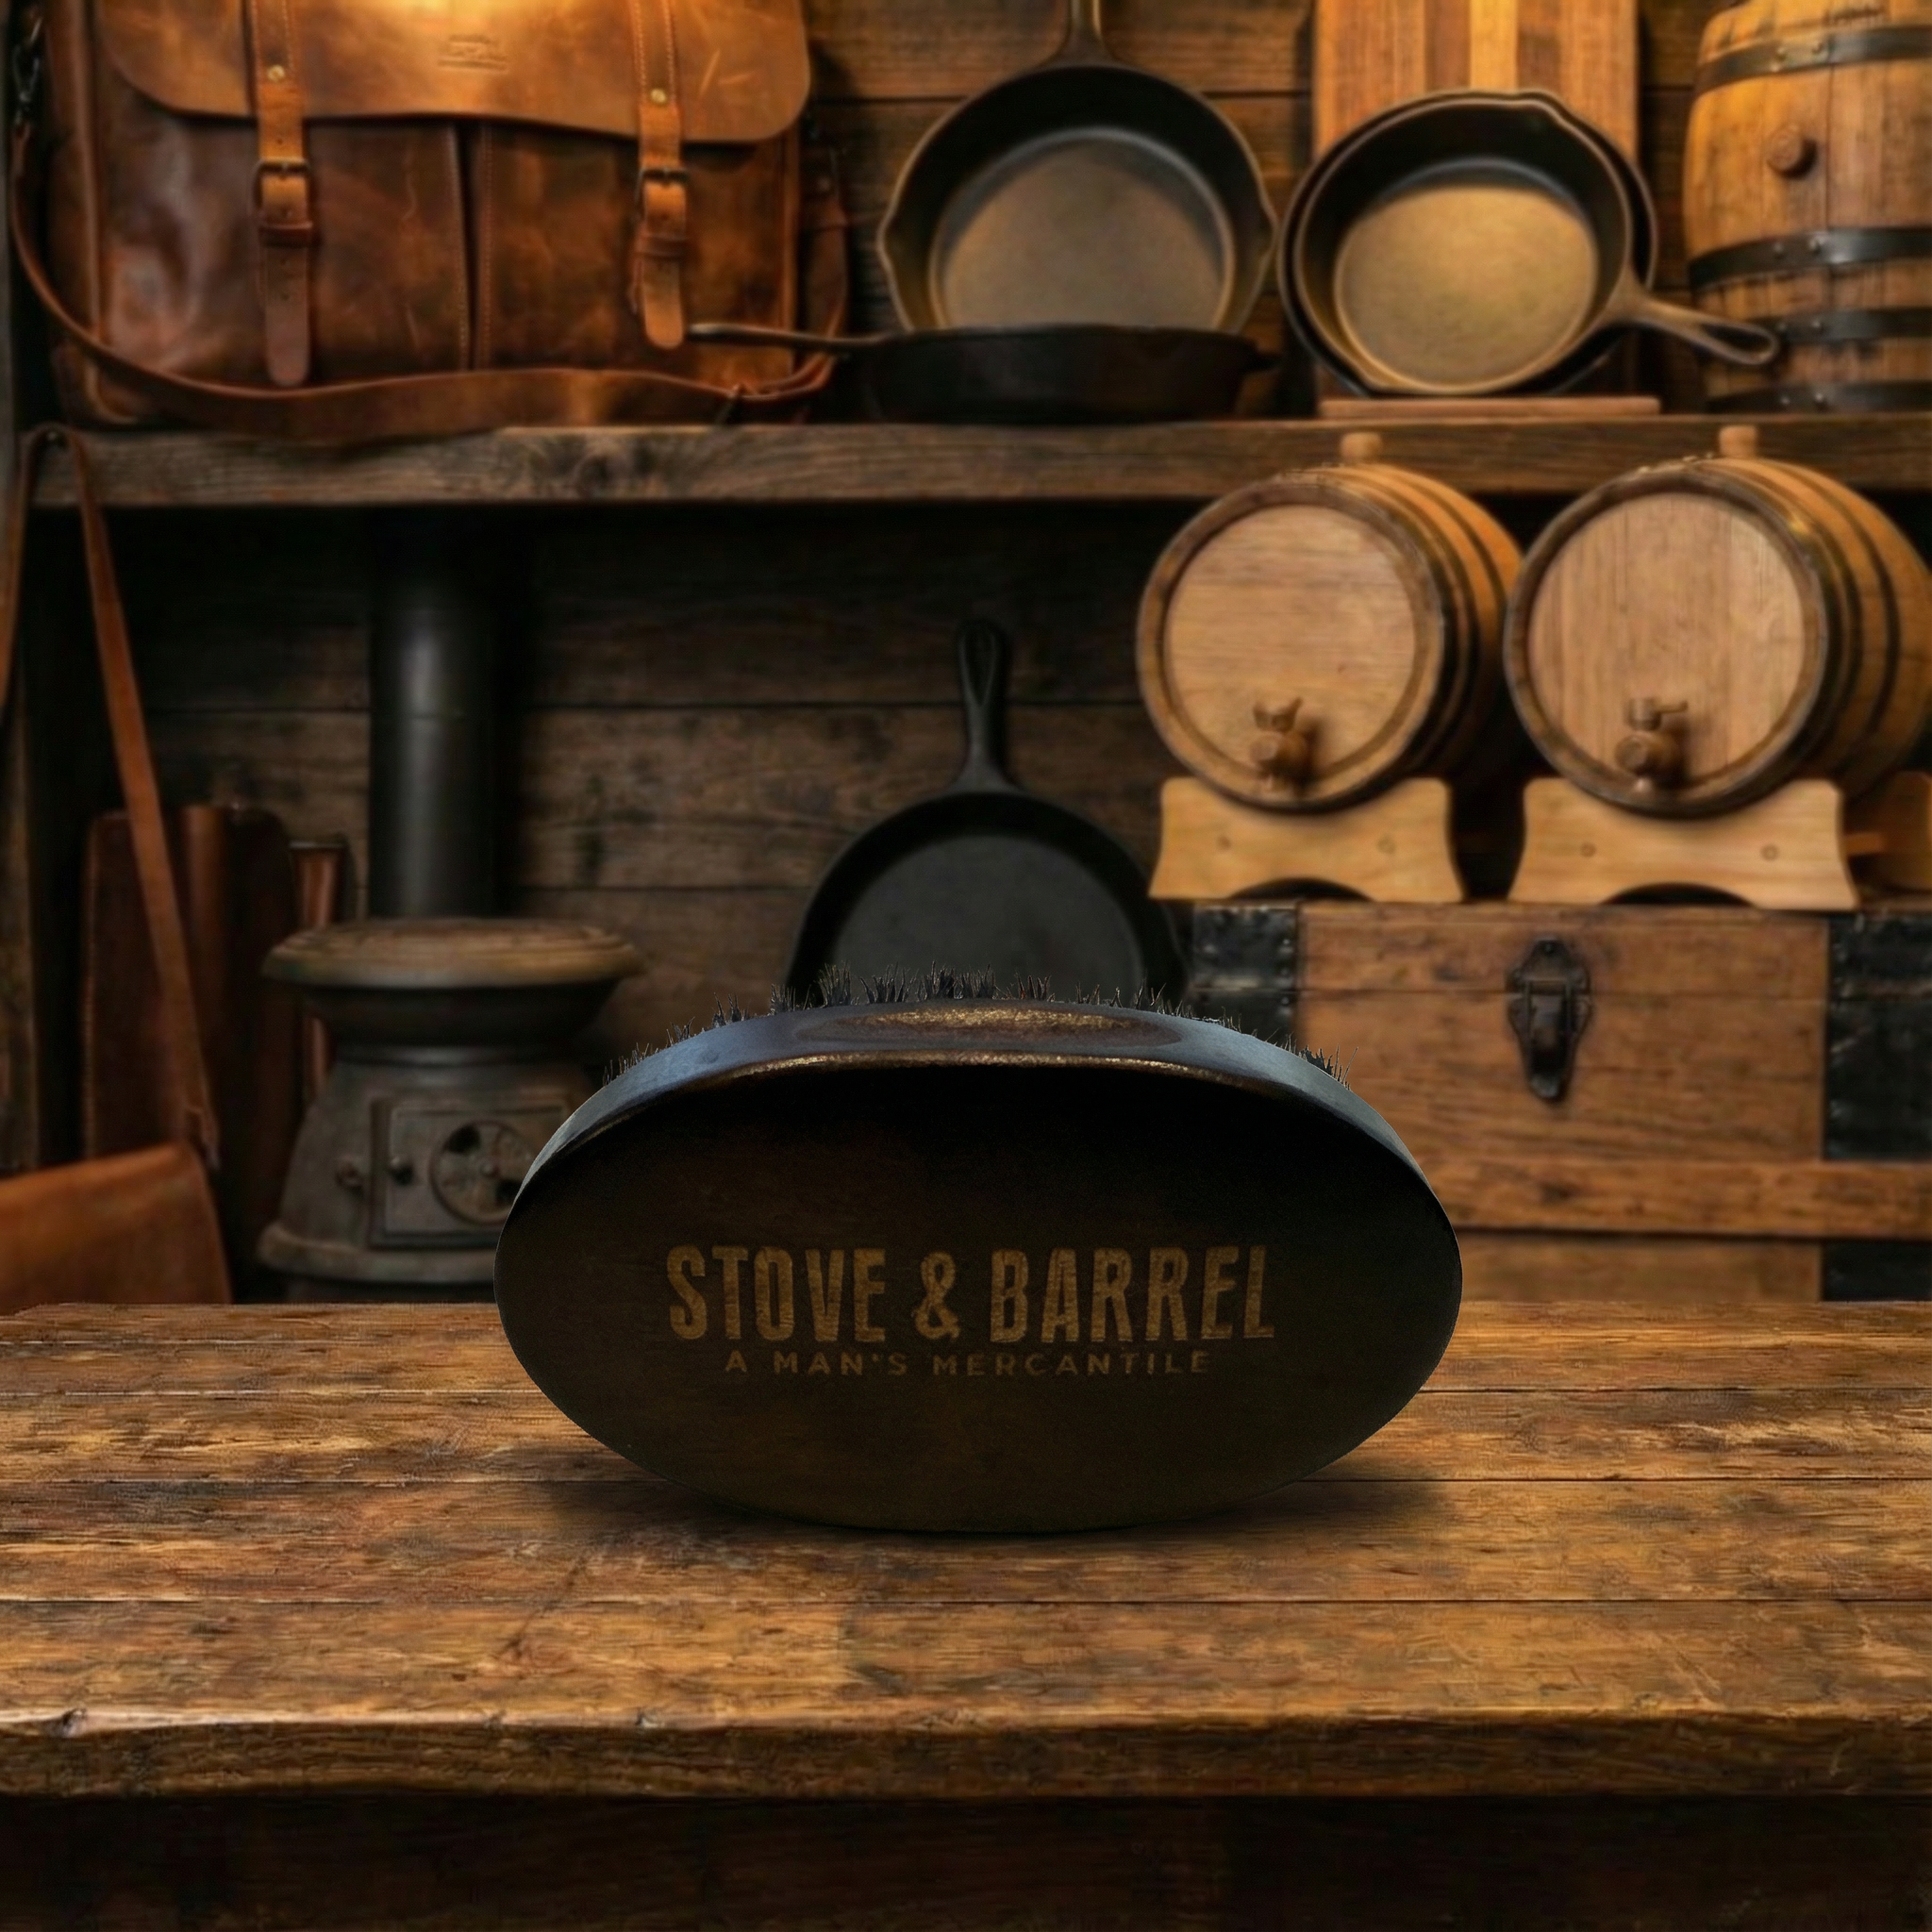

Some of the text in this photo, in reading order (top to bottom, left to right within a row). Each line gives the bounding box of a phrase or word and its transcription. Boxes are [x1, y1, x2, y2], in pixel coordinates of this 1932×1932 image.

[666, 1244, 1275, 1344] STOVE & BARREL
[724, 1349, 1209, 1376] A MAN'S MERCANTILE
